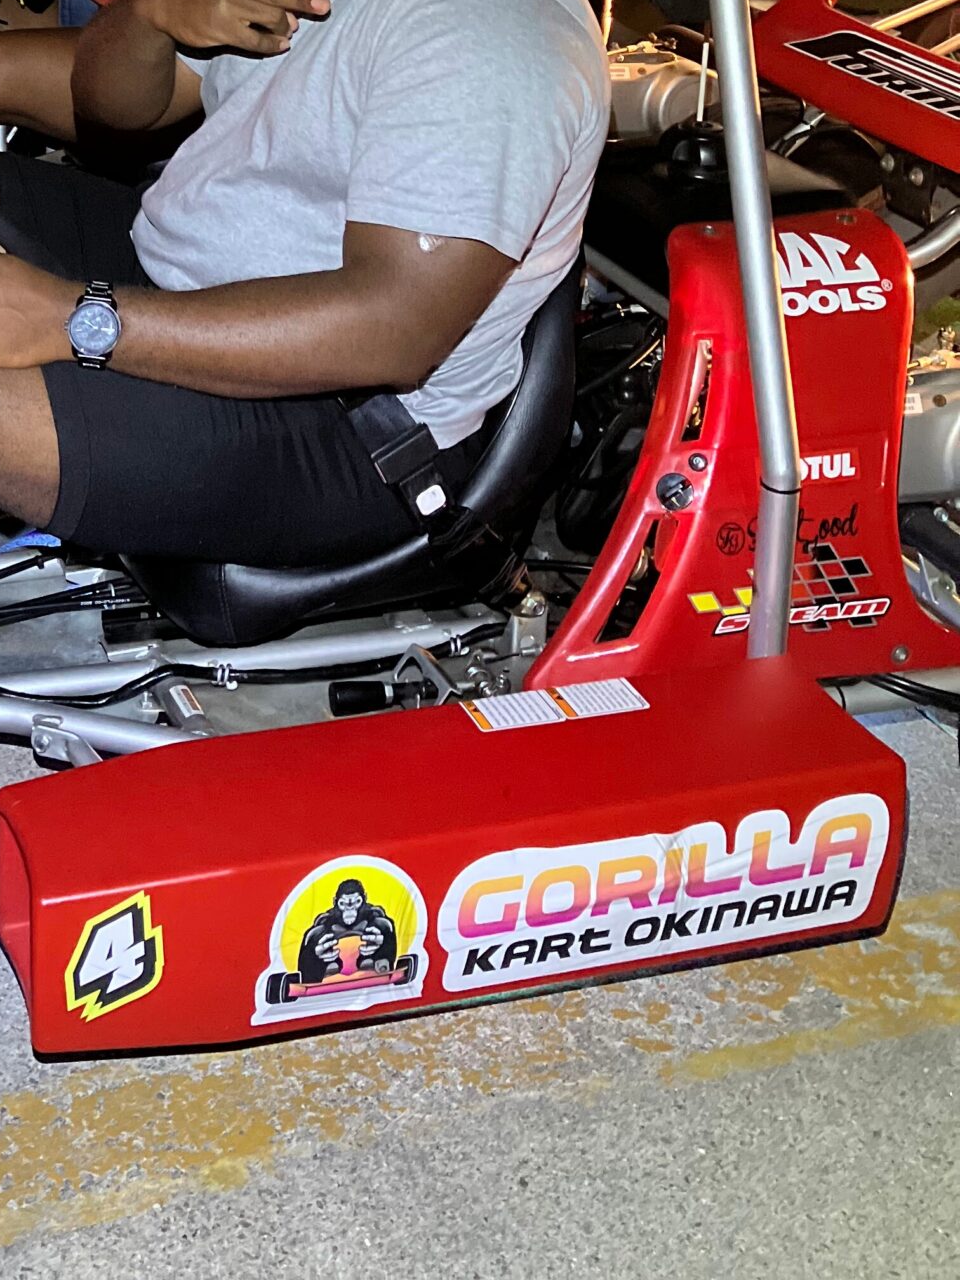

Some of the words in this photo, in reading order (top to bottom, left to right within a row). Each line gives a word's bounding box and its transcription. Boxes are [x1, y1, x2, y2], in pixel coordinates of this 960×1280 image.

[777, 231, 881, 289] AC
[781, 285, 887, 317] OOLS
[458, 812, 872, 939] GORILLA
[624, 879, 857, 947] OKINAWA
[79, 911, 145, 994] 4
